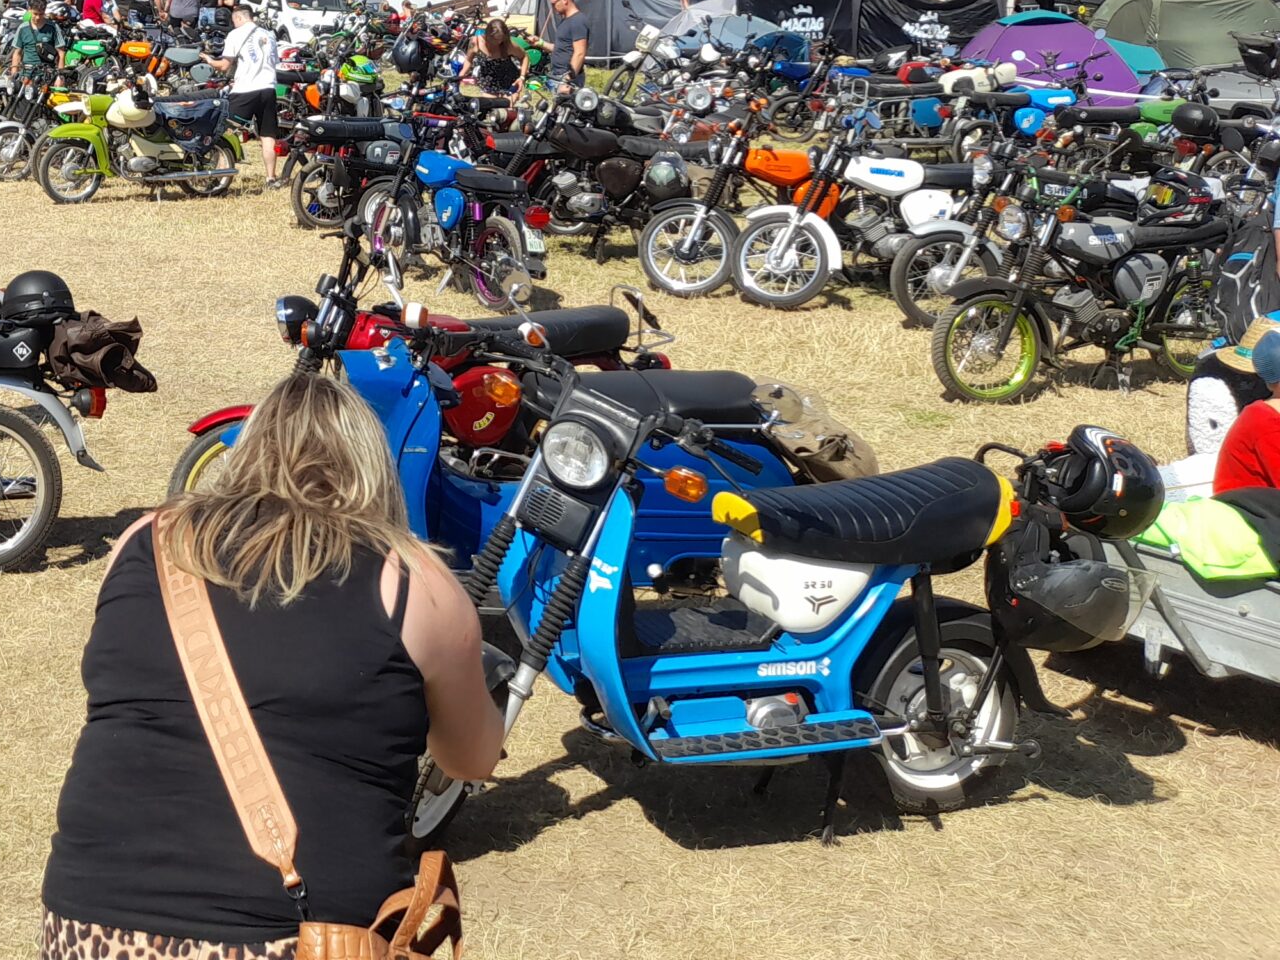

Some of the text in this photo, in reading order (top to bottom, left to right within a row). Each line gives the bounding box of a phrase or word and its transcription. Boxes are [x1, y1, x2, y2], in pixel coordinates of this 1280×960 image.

[781, 17, 824, 32] MACIAG
[803, 581, 817, 589] SR
[757, 660, 817, 677] simson
